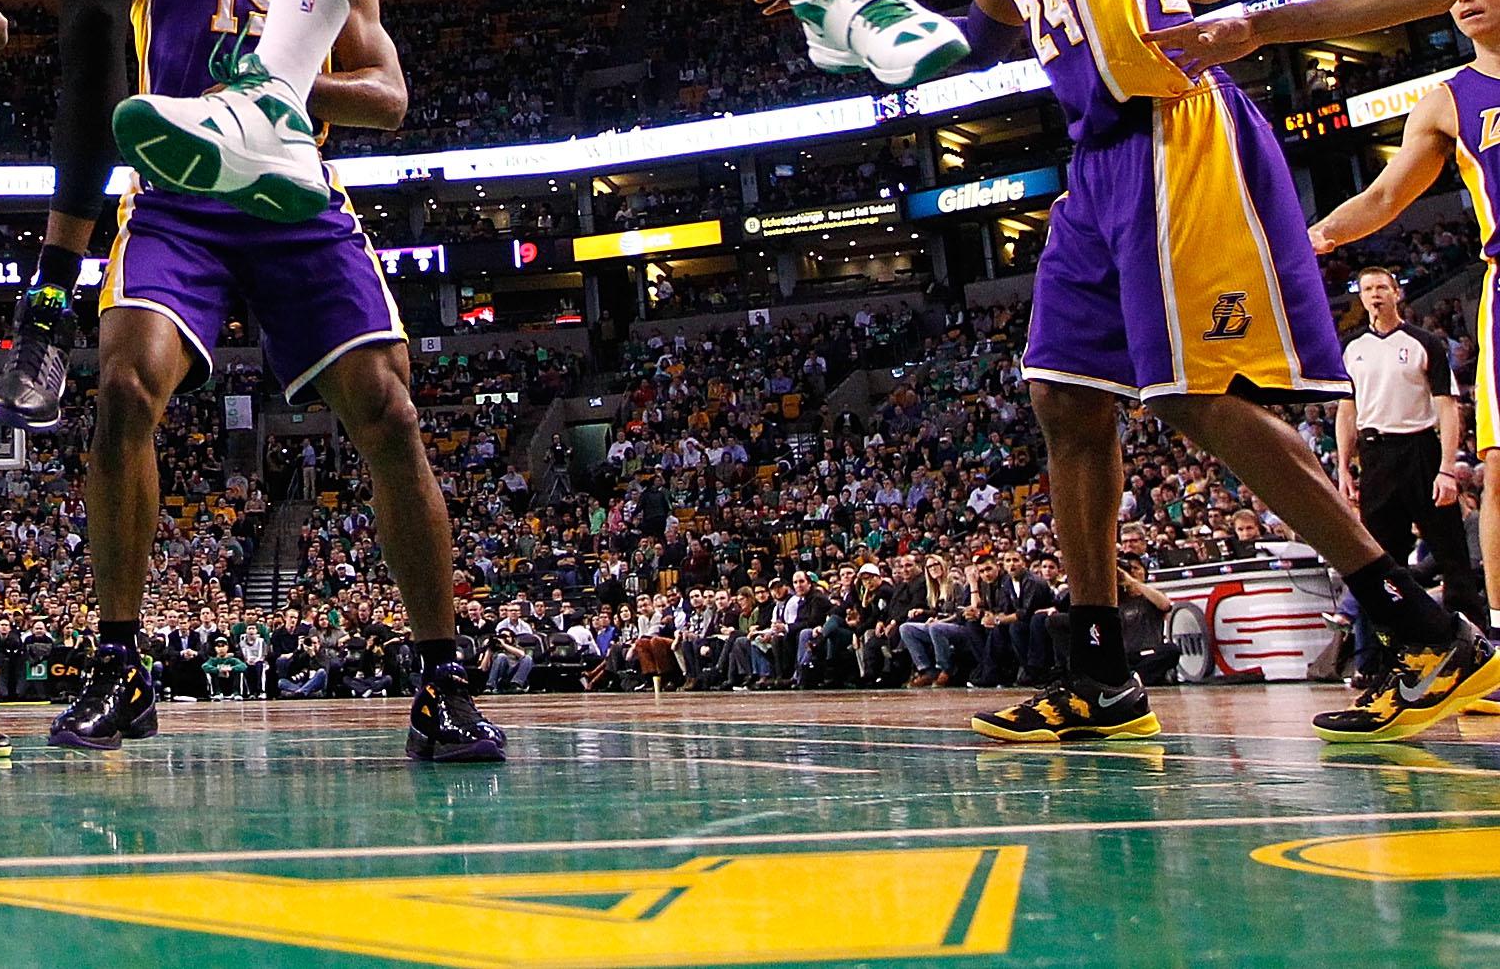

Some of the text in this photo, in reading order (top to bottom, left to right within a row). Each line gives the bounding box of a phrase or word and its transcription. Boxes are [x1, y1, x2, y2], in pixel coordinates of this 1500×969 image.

[937, 178, 1025, 212] Gillette
[520, 242, 537, 263] 9
[427, 339, 435, 350] 8
